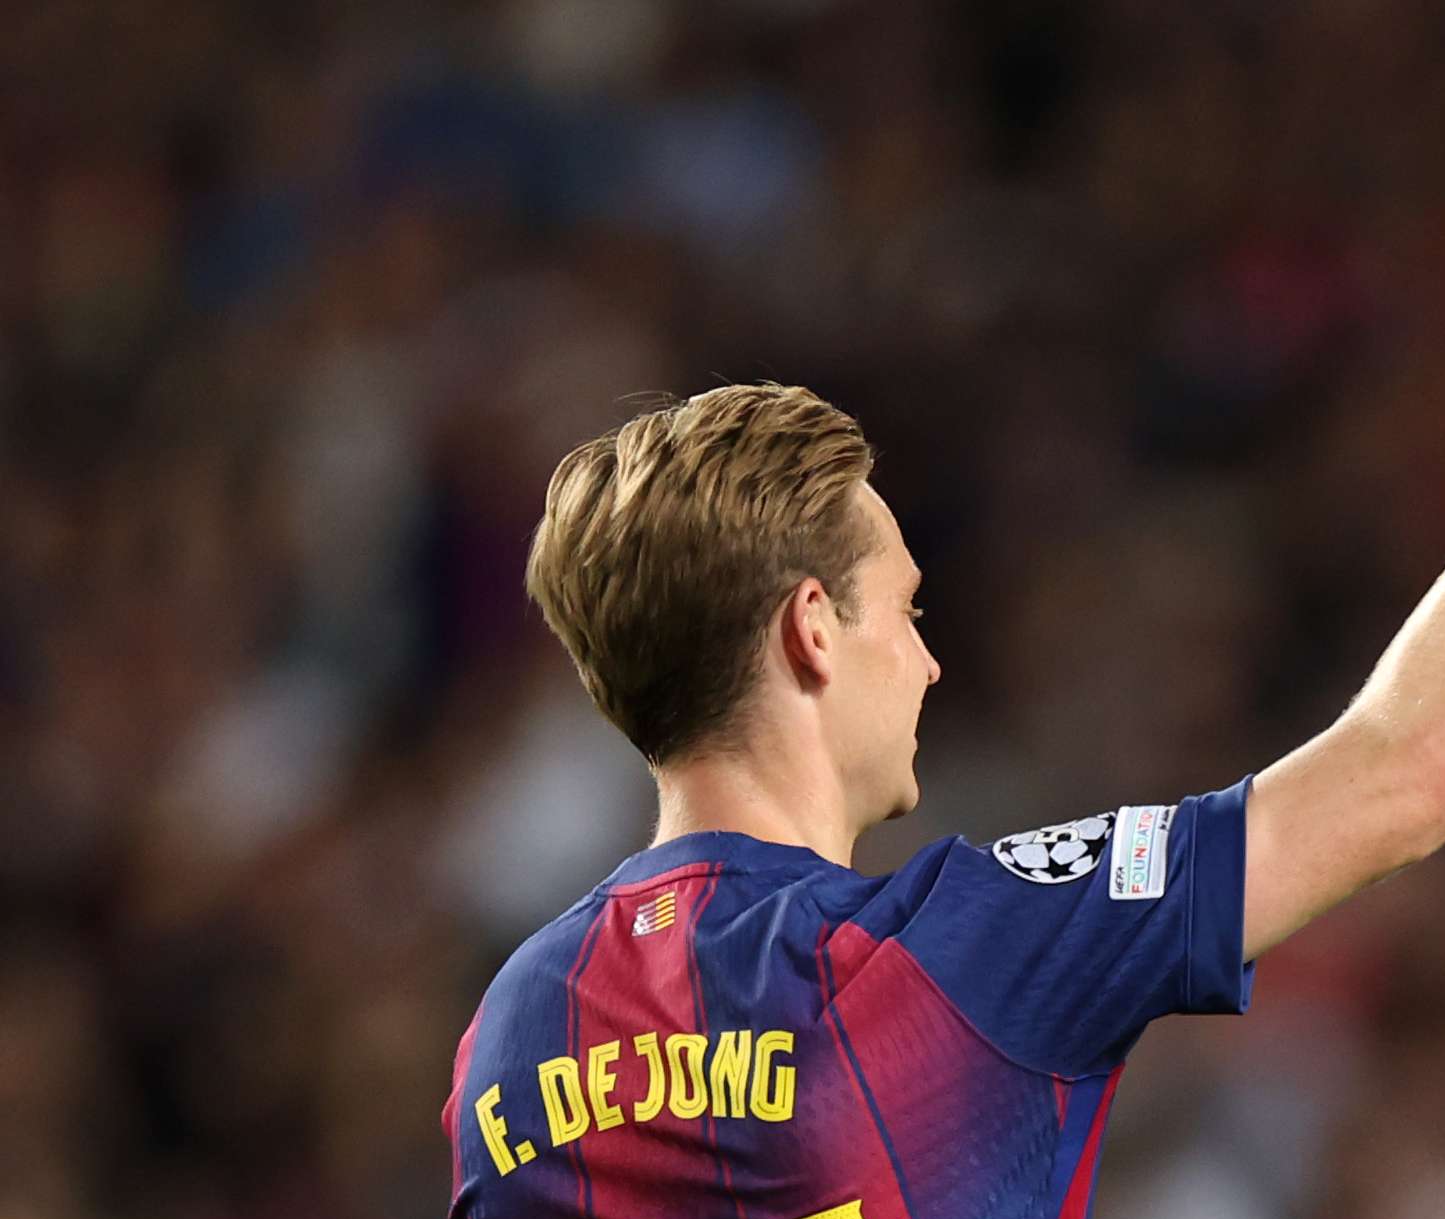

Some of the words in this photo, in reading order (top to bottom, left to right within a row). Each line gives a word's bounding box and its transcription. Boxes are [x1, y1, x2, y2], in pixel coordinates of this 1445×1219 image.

[475, 1083, 537, 1177] F.
[537, 1040, 625, 1147] DE
[633, 1030, 796, 1122] JONG
